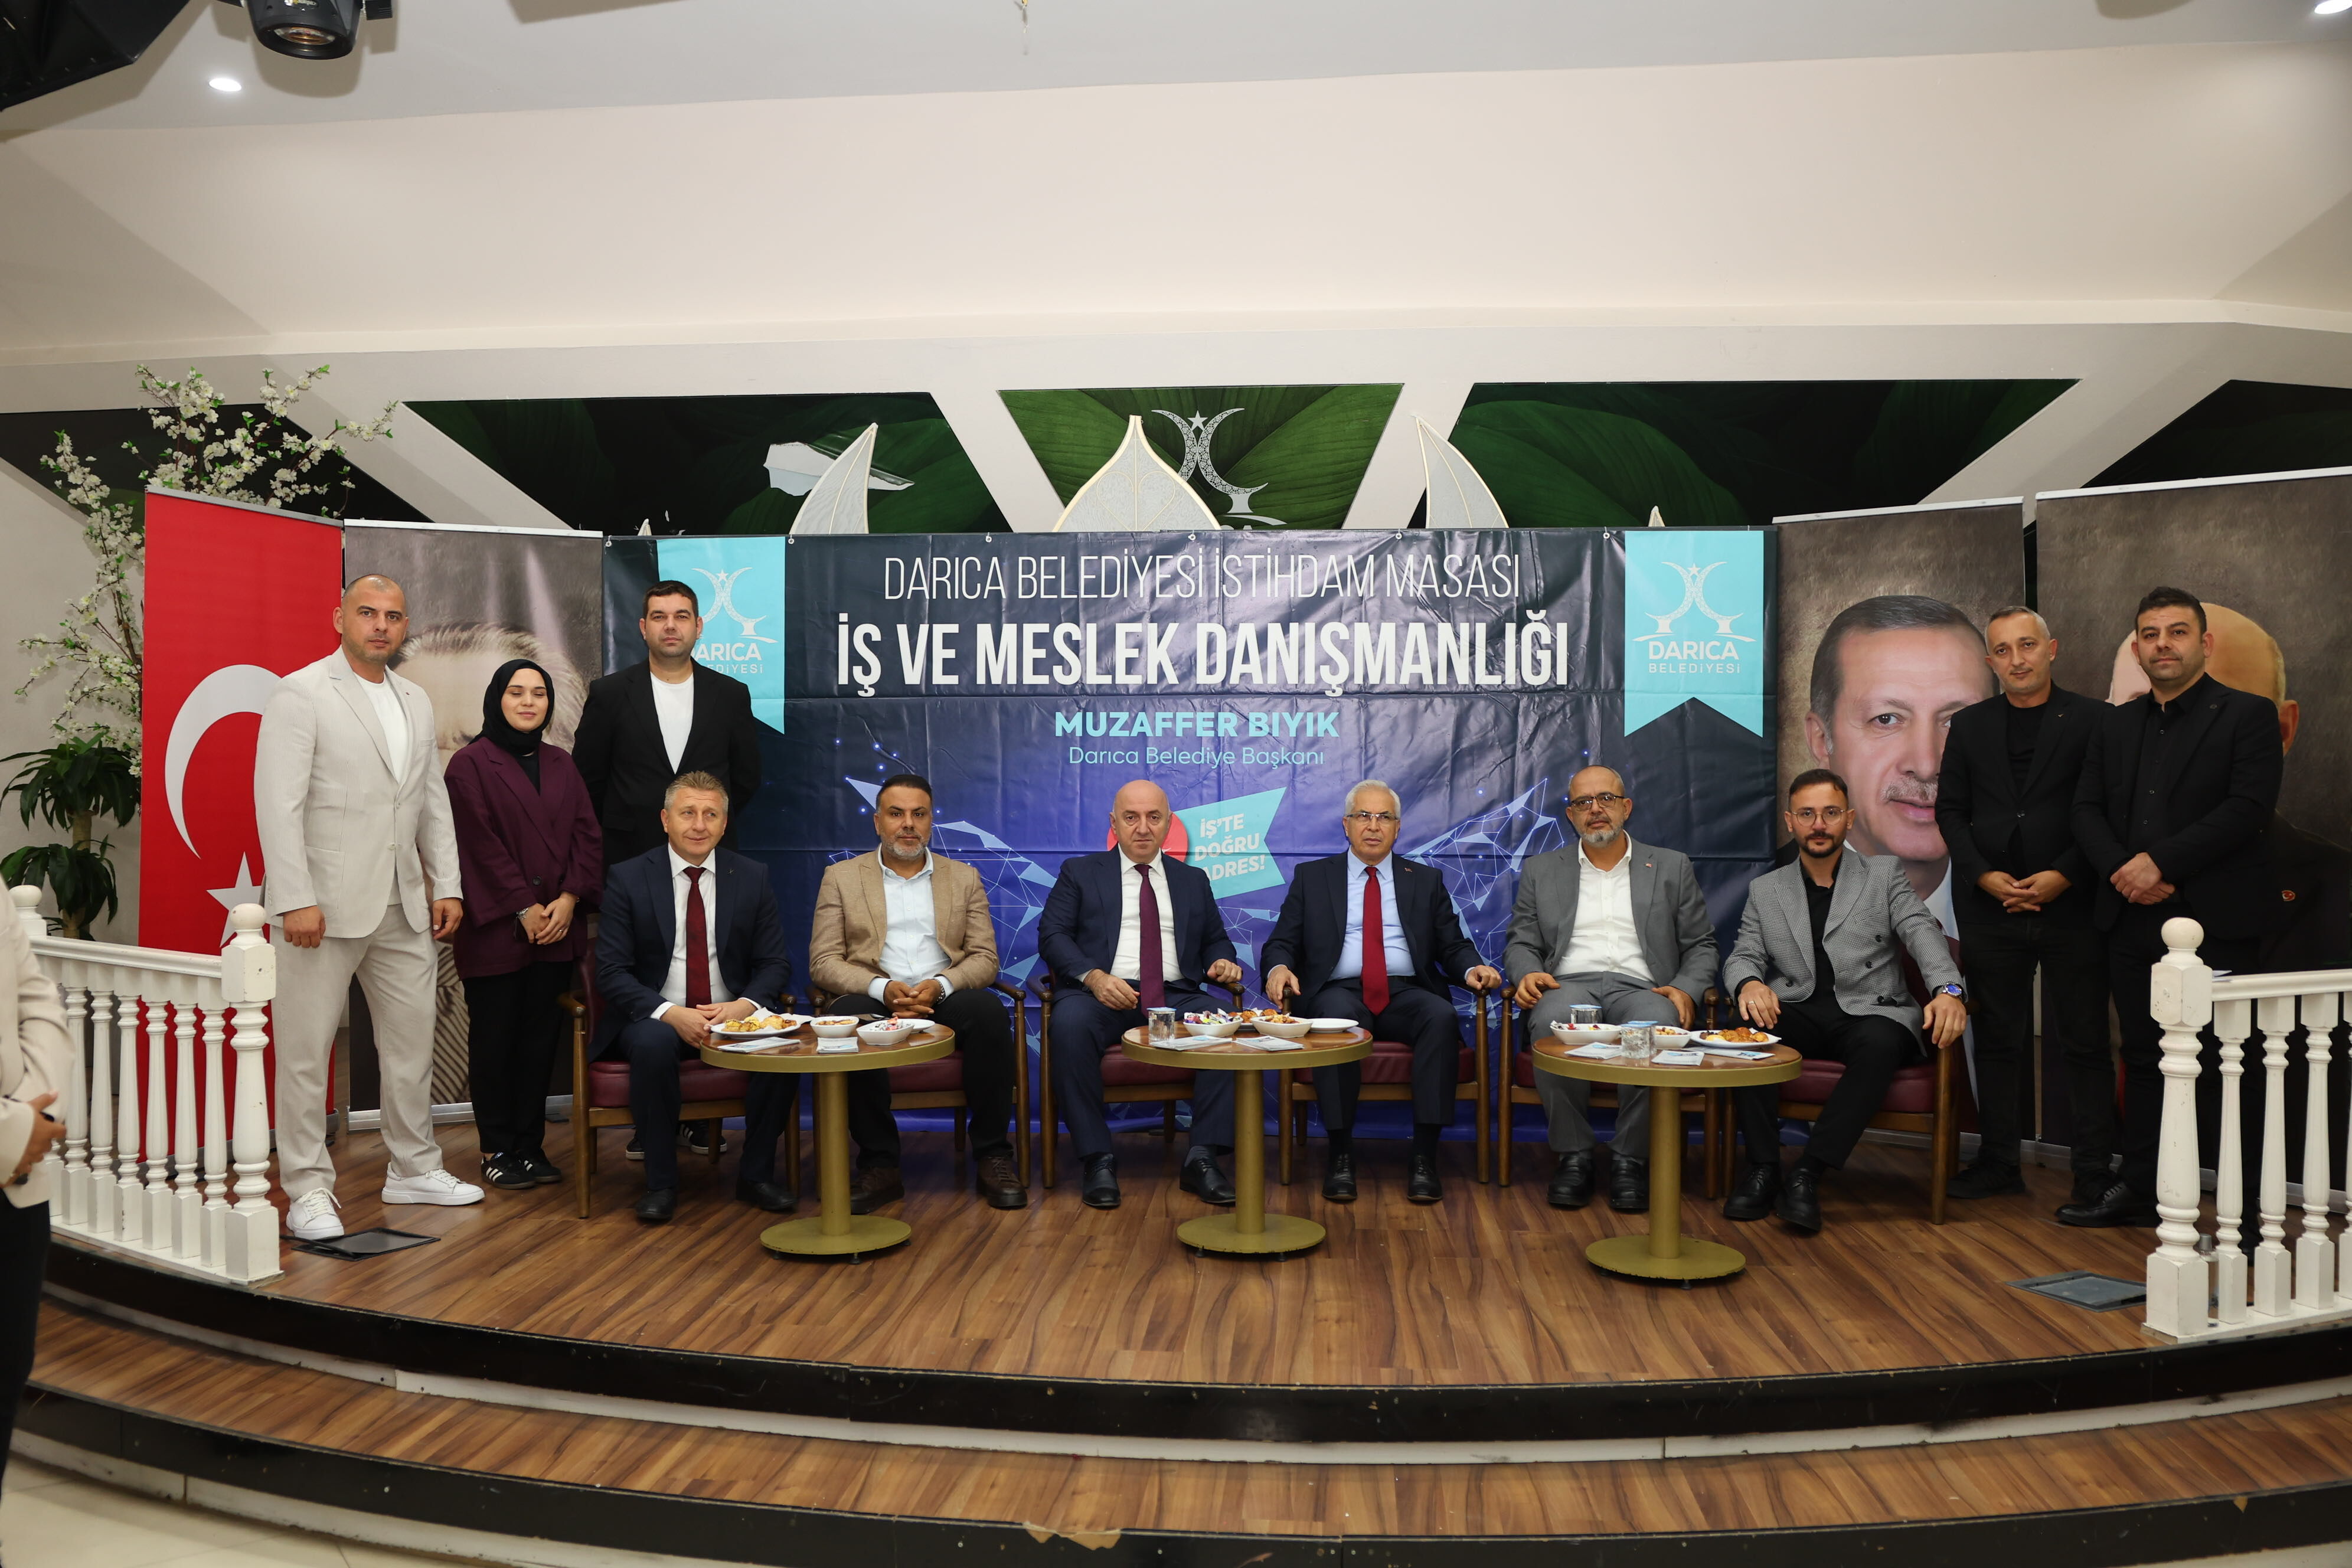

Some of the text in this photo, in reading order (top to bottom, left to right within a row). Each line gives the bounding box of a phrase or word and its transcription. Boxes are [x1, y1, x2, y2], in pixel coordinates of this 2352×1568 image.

[884, 547, 1519, 600] DARICA BELEDİYESİ İSTİHDAM MASASI
[838, 609, 1568, 697] İŞ VE MESLEK DANIŞMANLIĞI
[1648, 641, 1740, 660] DARICA
[1055, 711, 1340, 737] MUZAFFER BIYIK
[1069, 746, 1324, 770] Darıca Belediye Başkanı
[1194, 832, 1260, 861] DOĞRU
